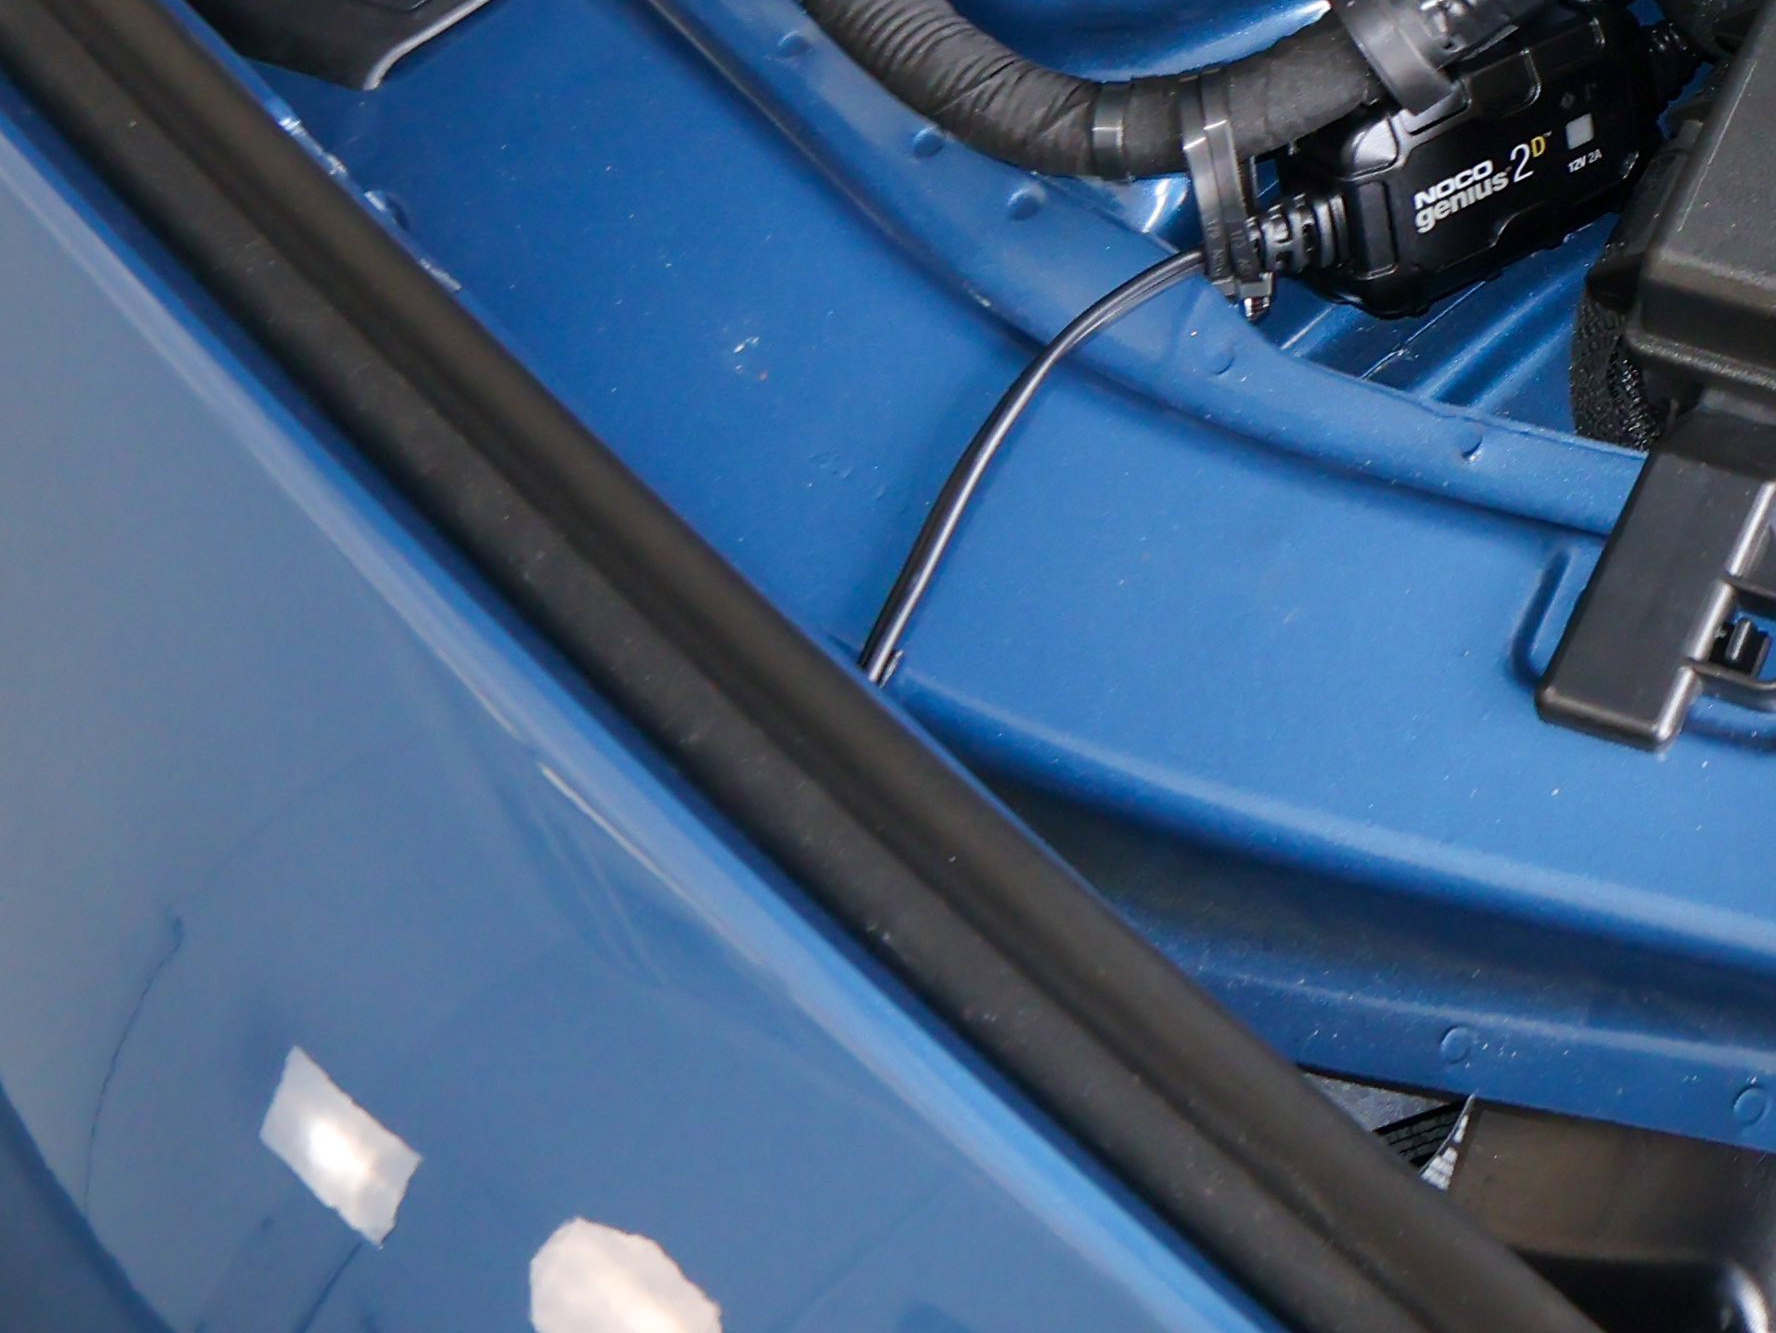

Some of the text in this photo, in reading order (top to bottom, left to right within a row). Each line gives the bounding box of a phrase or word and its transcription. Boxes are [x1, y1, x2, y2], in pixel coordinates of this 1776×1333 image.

[1413, 159, 1494, 209] NOCO
[1567, 149, 1603, 173] 12V 2A
[1415, 170, 1510, 233] genius
